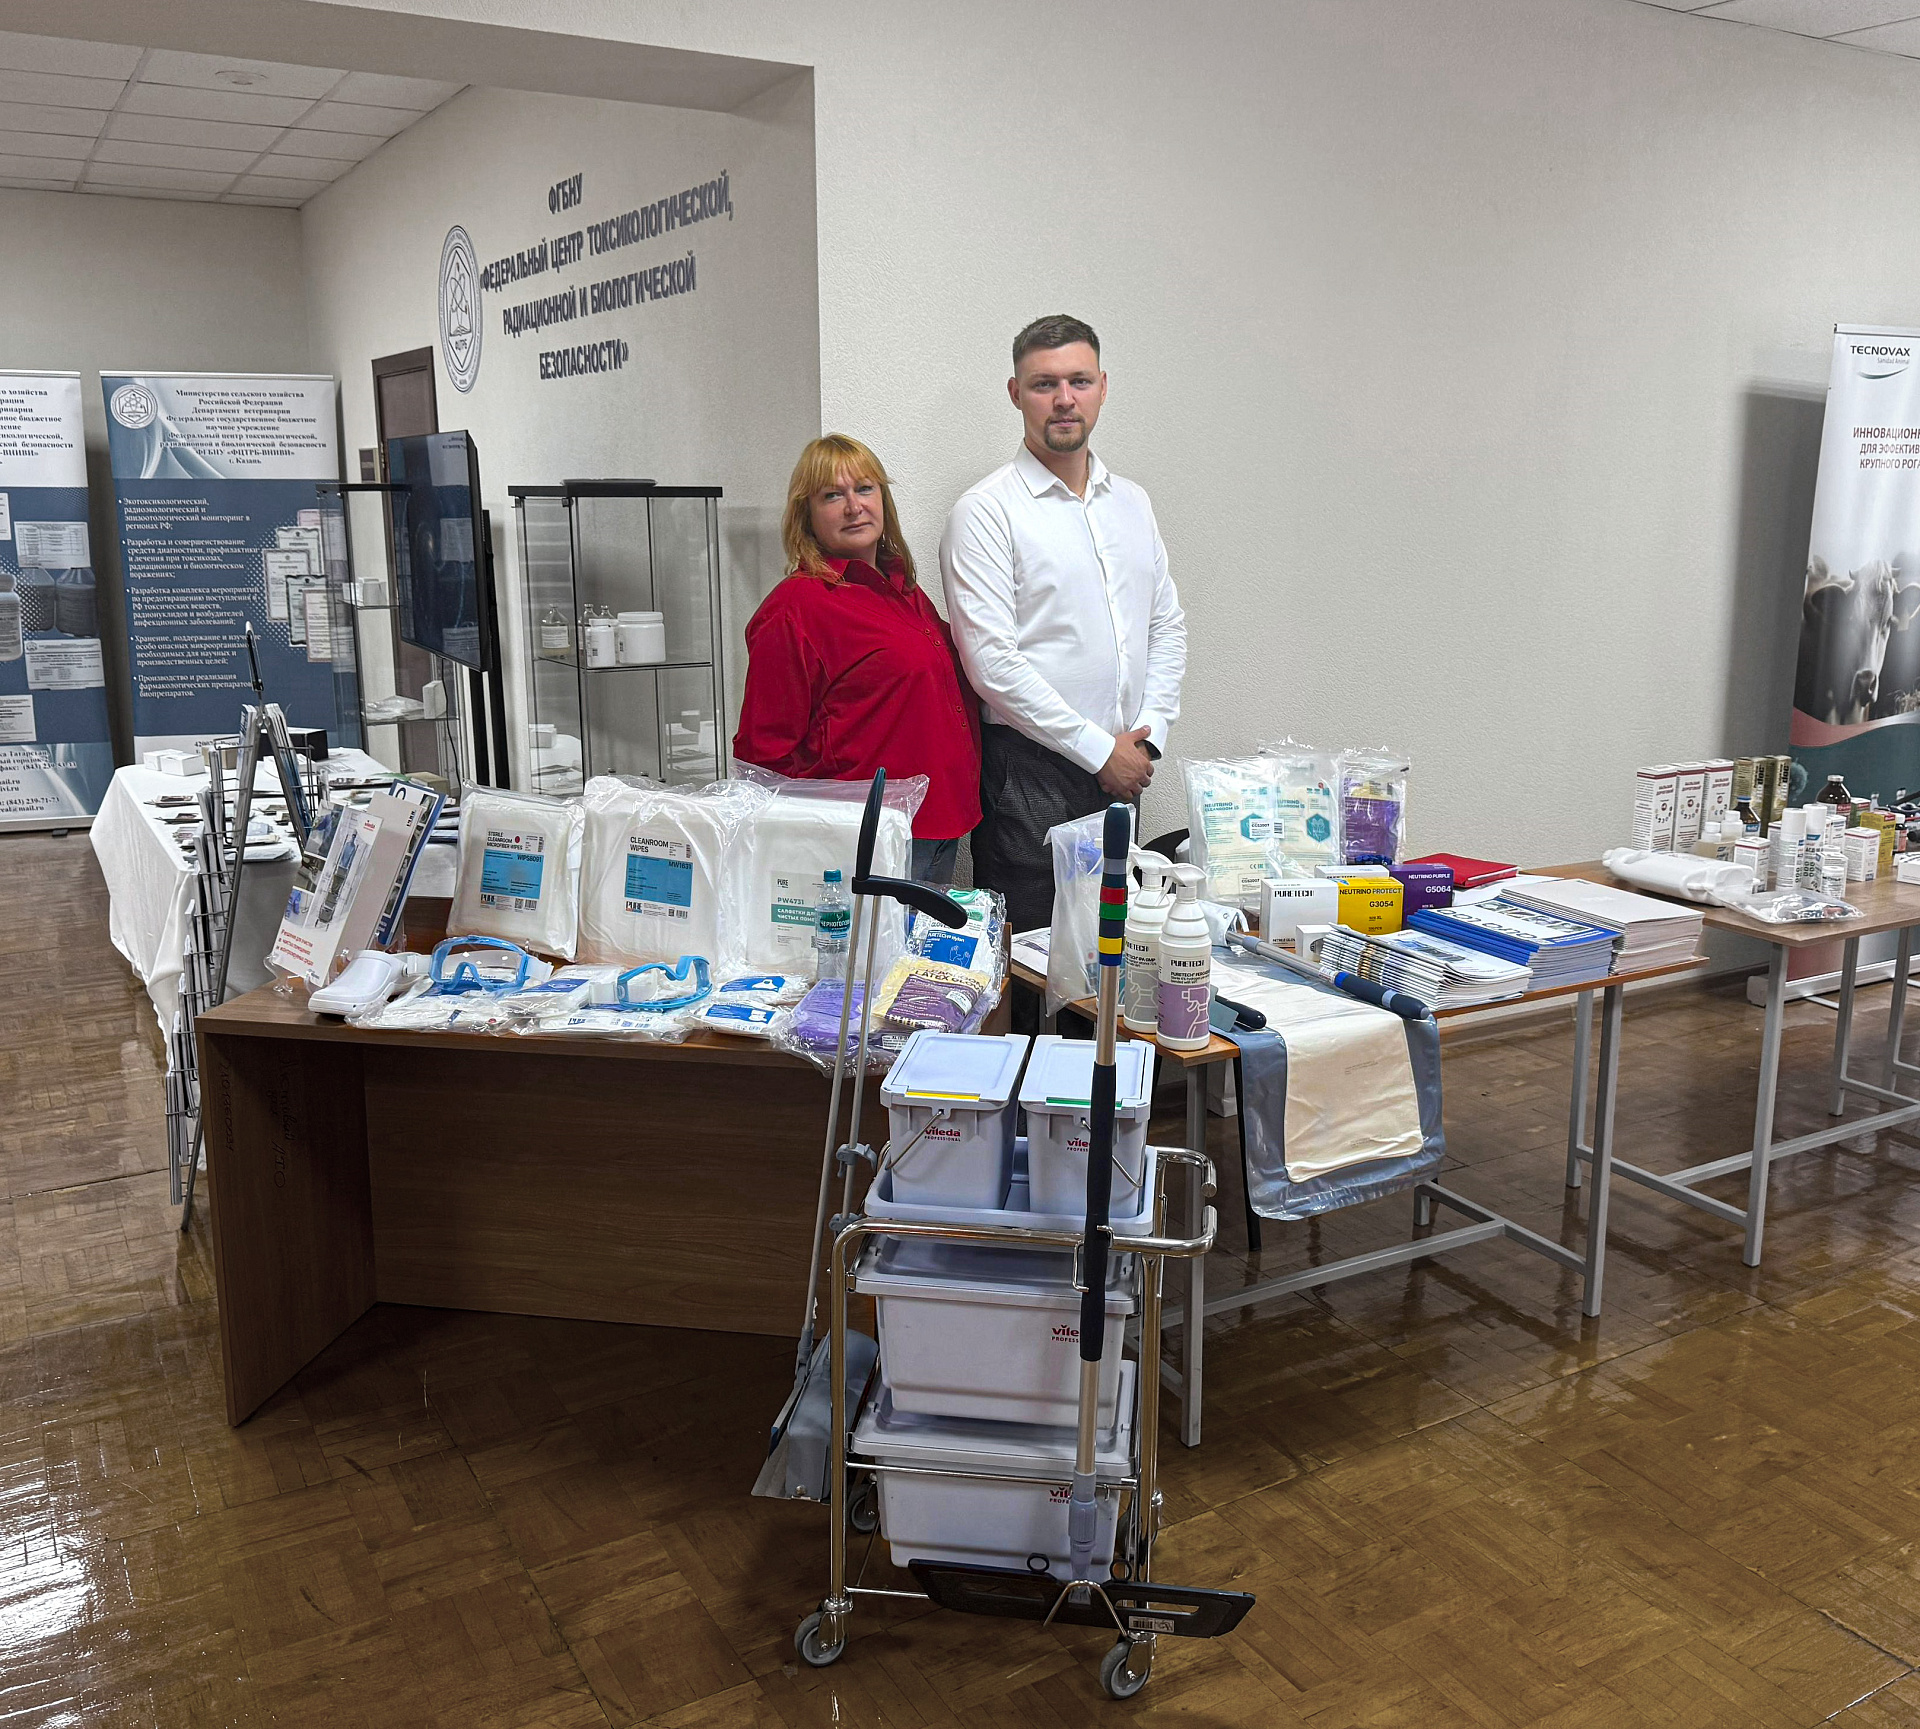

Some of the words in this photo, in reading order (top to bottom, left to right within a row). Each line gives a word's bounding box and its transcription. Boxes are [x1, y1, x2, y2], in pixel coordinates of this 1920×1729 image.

[549, 172, 583, 214] ФГБНУ
[550, 230, 584, 274] ЦЕНТР
[587, 169, 734, 255] ТОКСИКОЛОГИЧЕСКОЙ,
[503, 285, 577, 339] РАДИАЦИОННОЙ
[580, 286, 588, 318] И
[591, 249, 697, 314] БИОЛОГИЧЕСКОЙ
[1850, 345, 1911, 357] TECNOVAX
[539, 338, 630, 380] БЕЗОПАСНОСТИ»
[176, 389, 230, 397] Министерство
[1860, 443, 1877, 455] ДЛЯ
[1859, 458, 1900, 469] КРУПНОГО
[630, 836, 669, 848] CLEANROOM
[630, 844, 649, 853] WIPES
[1425, 885, 1451, 894] G5064
[1369, 900, 1394, 908] G3054
[1170, 959, 1205, 968] PURETECH
[1066, 1137, 1090, 1147] vile
[1051, 1324, 1080, 1337] vile
